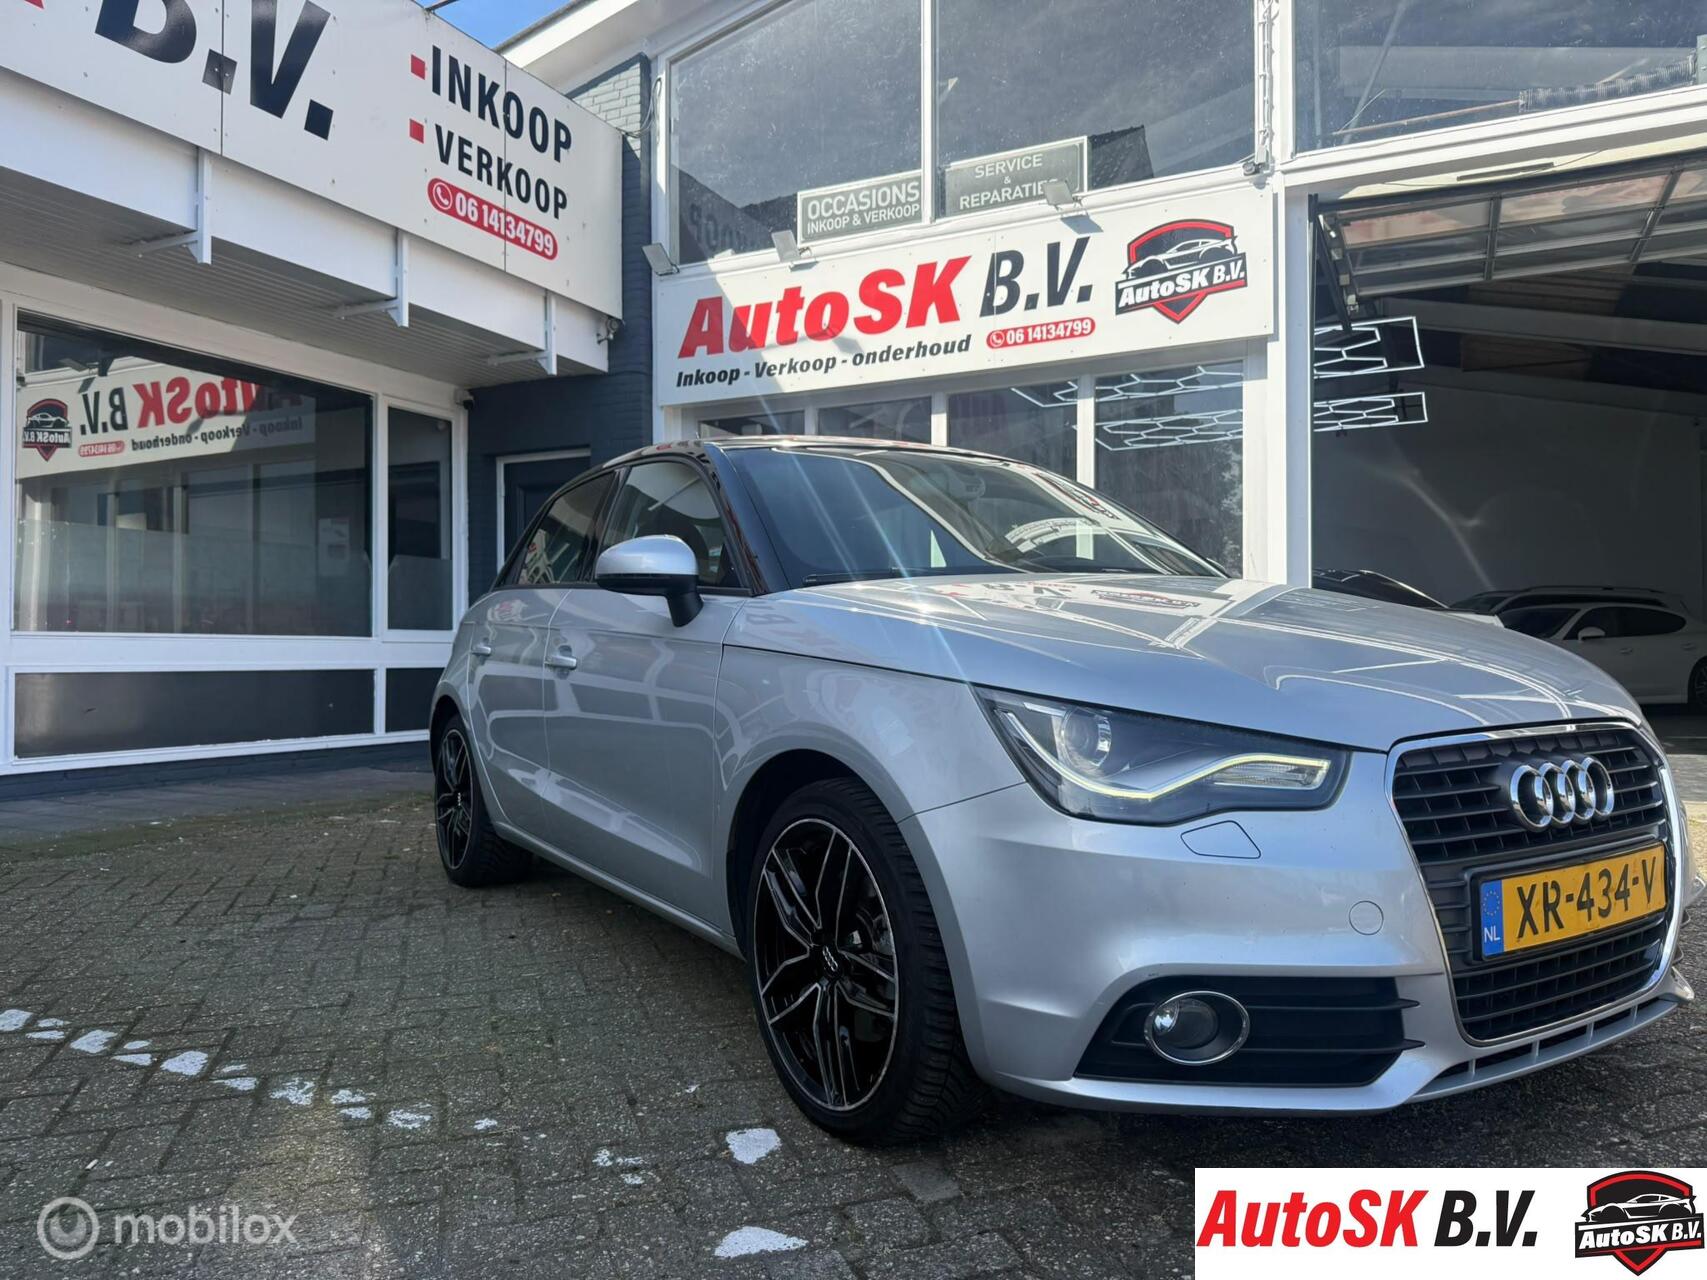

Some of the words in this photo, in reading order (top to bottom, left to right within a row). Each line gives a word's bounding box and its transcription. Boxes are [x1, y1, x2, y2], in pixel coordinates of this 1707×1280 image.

[432, 45, 572, 163] INKOOP
[435, 124, 568, 220] VERKOOP
[975, 154, 1043, 179] SERVICE
[1003, 176, 1011, 185] &
[807, 181, 920, 219] OCCASIONS
[959, 178, 1058, 210] REPARATIE
[455, 193, 478, 222] 06
[482, 205, 553, 256] 14134799
[807, 216, 850, 235] INKOOP
[852, 214, 862, 226] &
[865, 204, 920, 224] VERKOOP
[678, 256, 972, 359] AutoSK
[979, 236, 1093, 317] B.V.
[1118, 269, 1210, 308] AutoSK
[1213, 259, 1245, 285] B.V.
[1006, 327, 1024, 345] 06
[1028, 319, 1092, 342] 14134799
[676, 368, 740, 388] Inkoop
[755, 356, 836, 379] Verkoop
[852, 335, 972, 366] onderhoud
[1516, 856, 1656, 939] XR-434-V
[1484, 926, 1501, 942] NL
